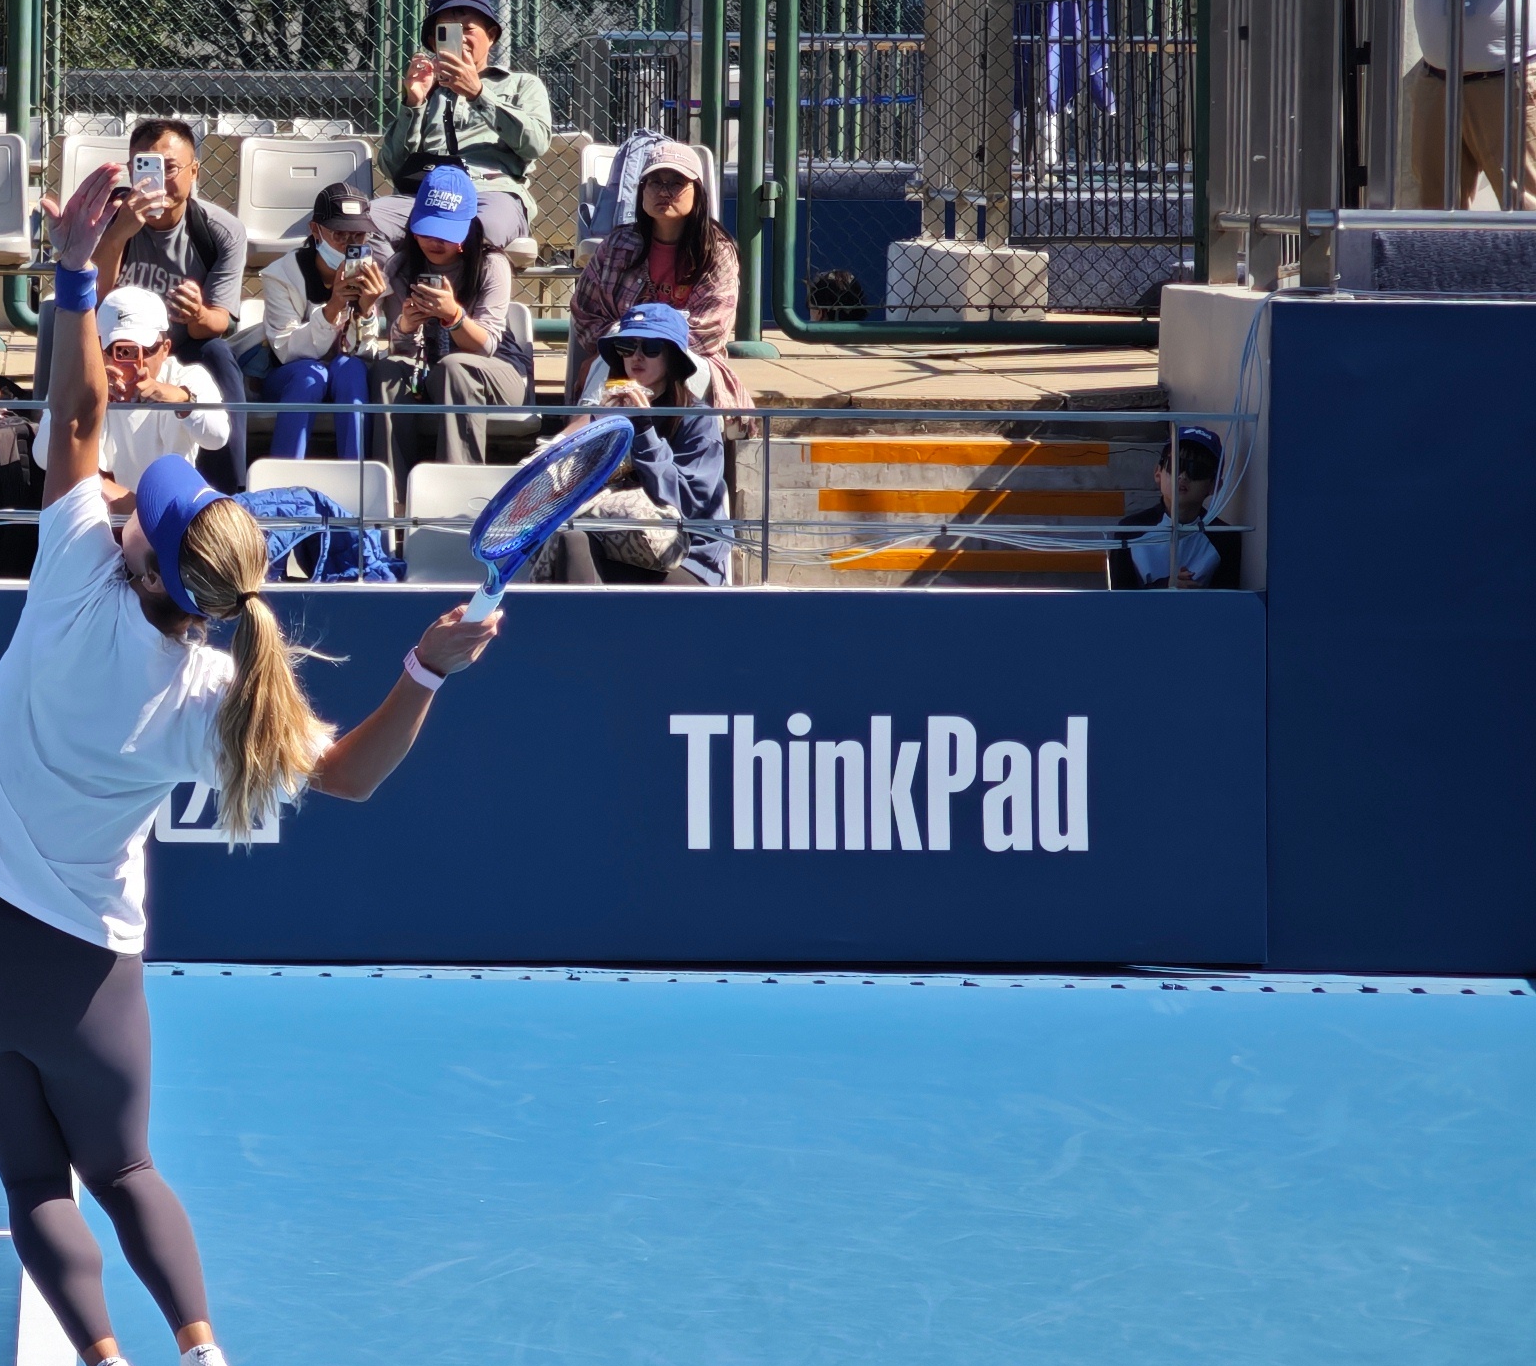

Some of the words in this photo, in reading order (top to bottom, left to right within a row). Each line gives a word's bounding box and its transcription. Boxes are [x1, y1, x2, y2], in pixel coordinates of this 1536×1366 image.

[424, 197, 458, 212] OPEN
[427, 189, 463, 205] CHINA
[669, 712, 1089, 853] ThinkPad
